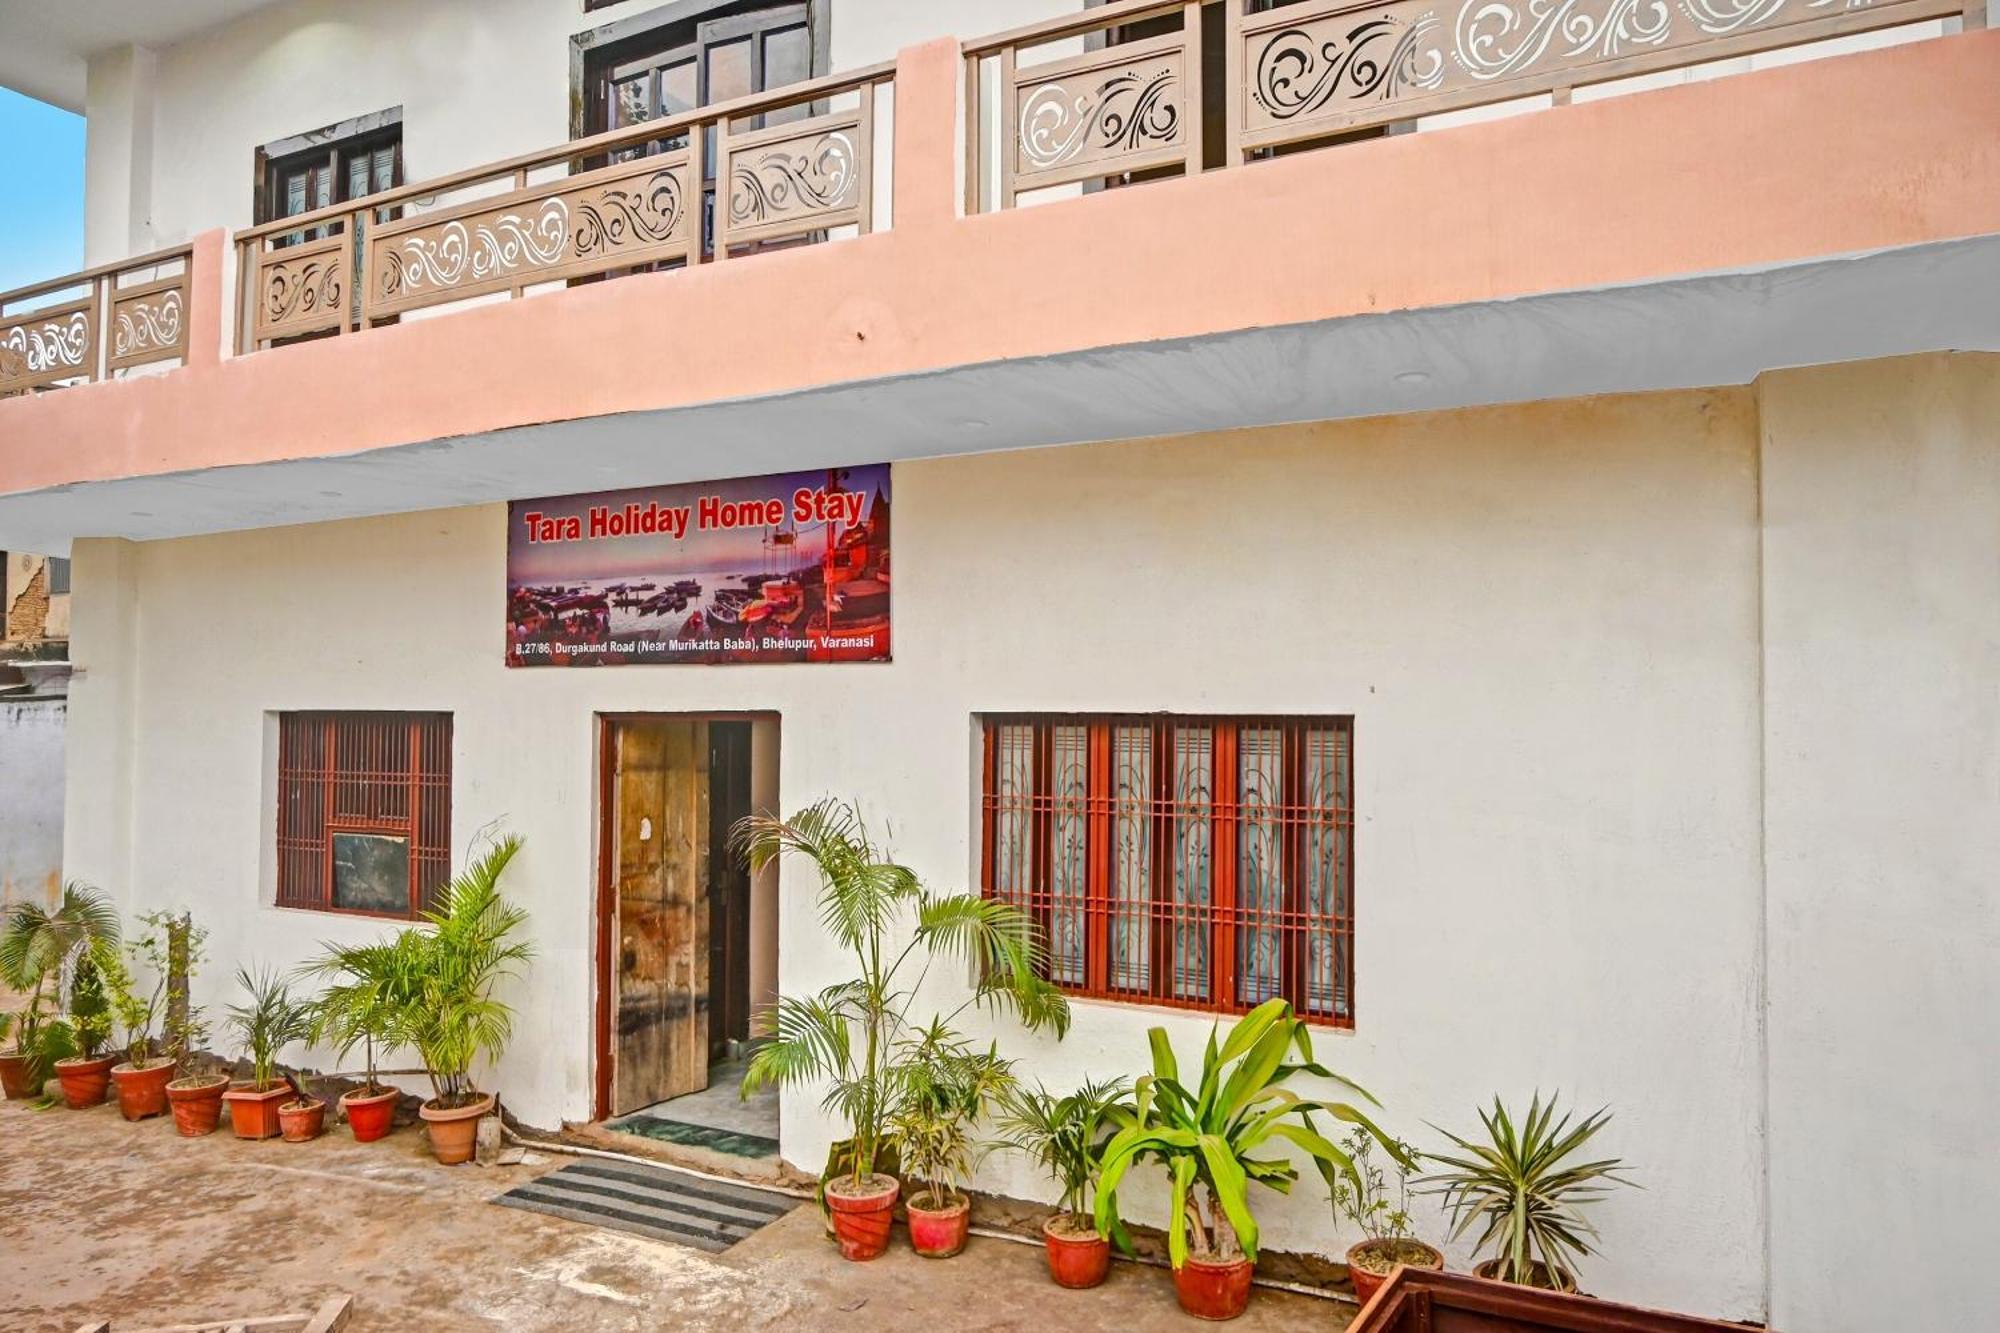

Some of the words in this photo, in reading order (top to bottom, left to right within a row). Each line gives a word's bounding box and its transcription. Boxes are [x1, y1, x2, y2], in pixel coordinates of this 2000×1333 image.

[525, 512, 581, 544] Tara
[589, 502, 690, 540] Holiday
[699, 495, 783, 529] Home
[793, 487, 866, 529] Stay
[555, 641, 607, 656] Durgakund
[610, 640, 635, 653] Road
[638, 639, 666, 654] (Near
[668, 639, 720, 652] Murikatta
[723, 637, 759, 653] Baba),
[762, 637, 817, 651] Bhelupur,
[820, 634, 874, 649] Varanasi
